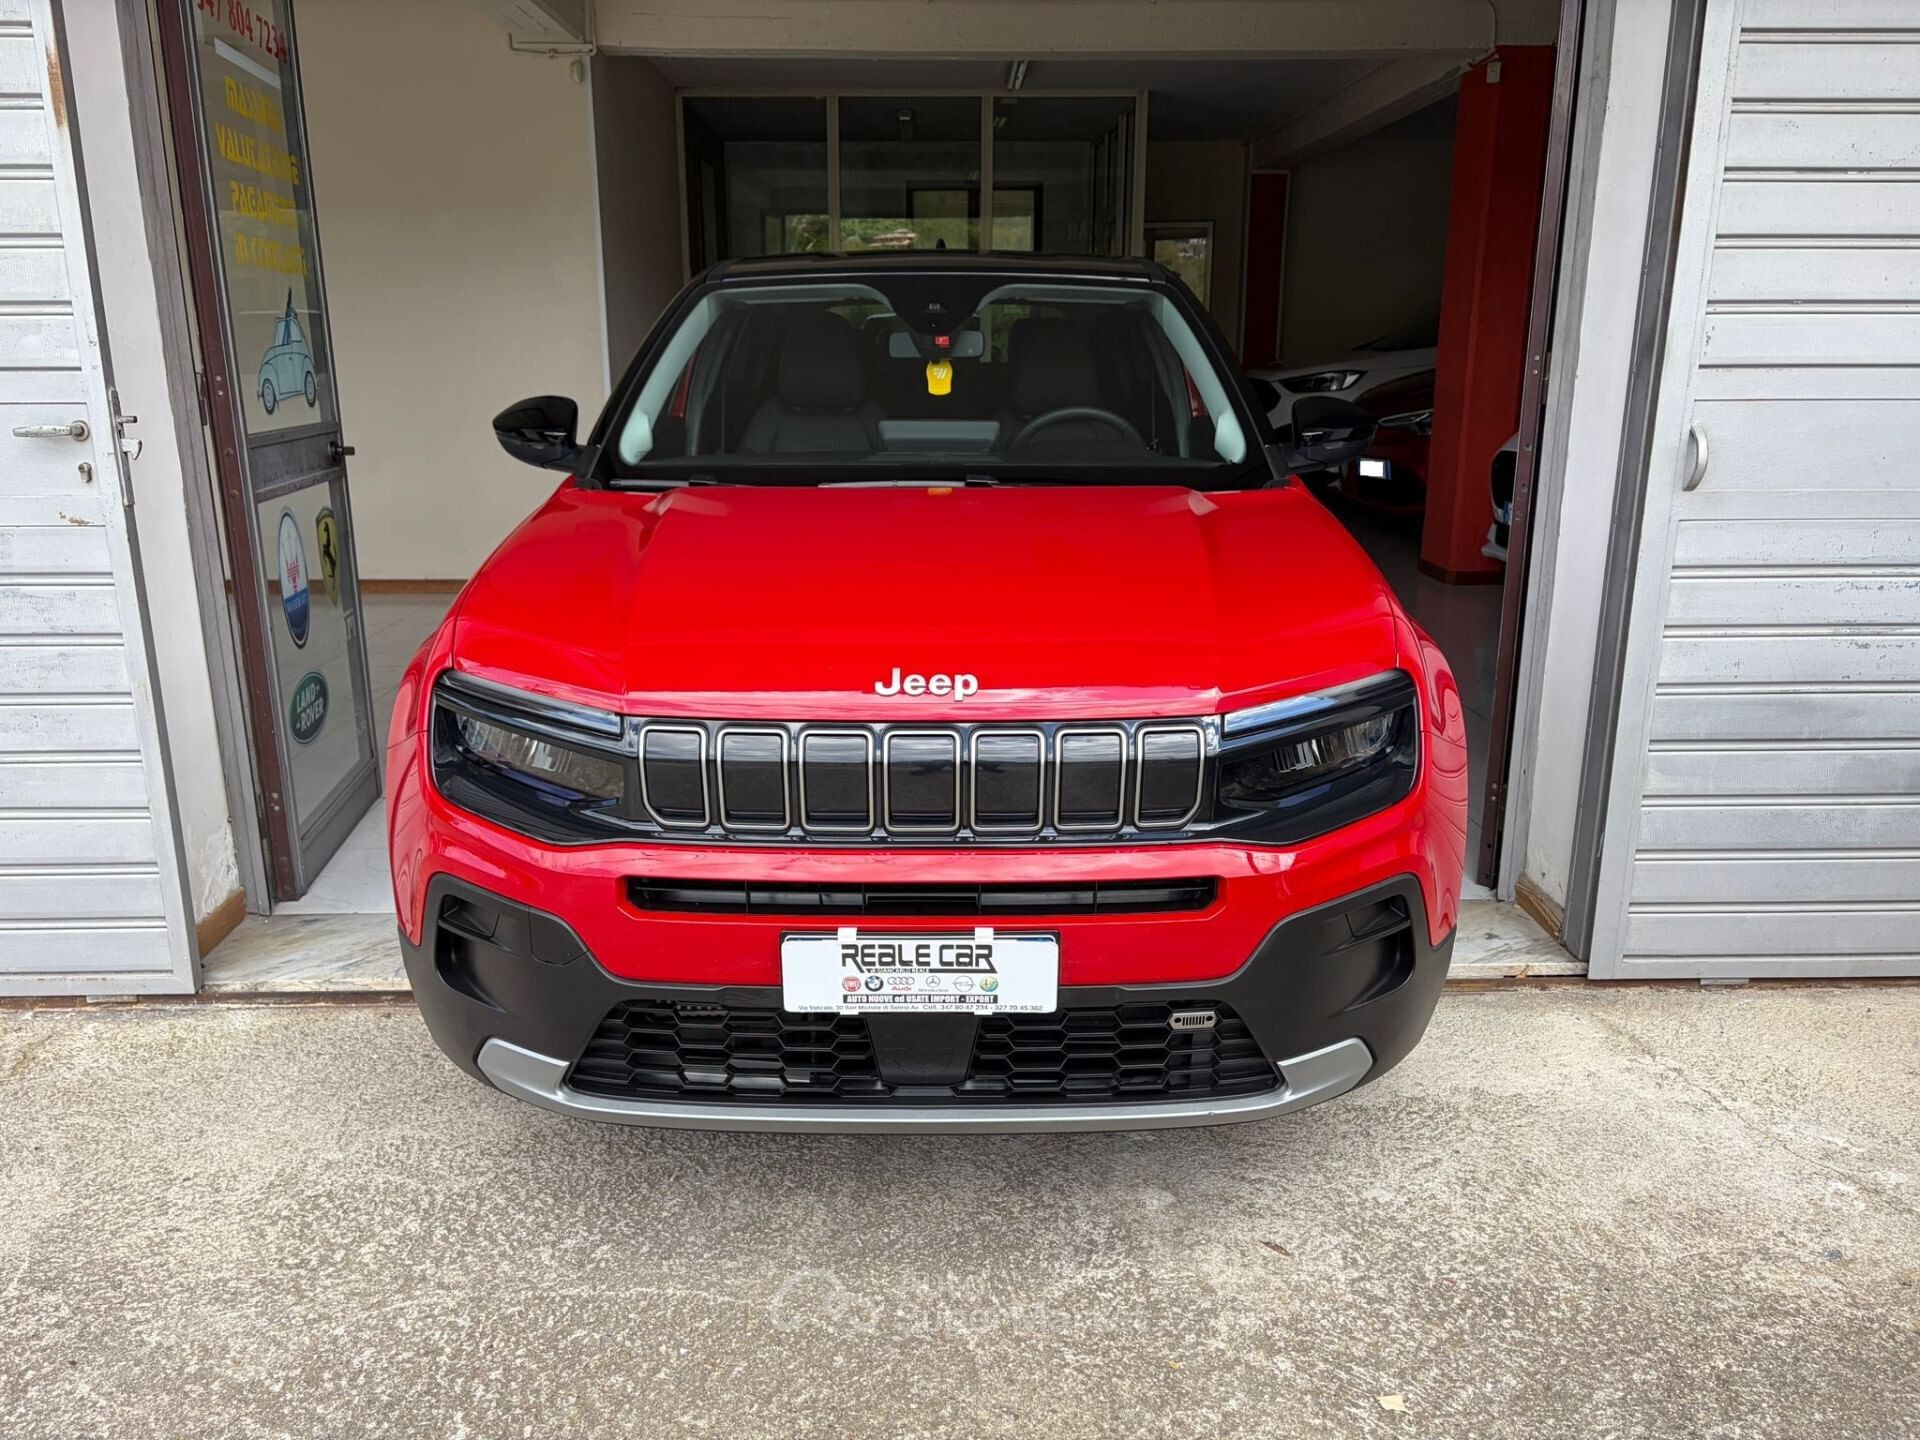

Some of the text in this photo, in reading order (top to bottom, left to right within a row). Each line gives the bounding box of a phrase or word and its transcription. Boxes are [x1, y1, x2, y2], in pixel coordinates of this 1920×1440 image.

[227, 0, 254, 43] 804
[256, 14, 288, 64] 7234
[296, 683, 316, 714] LAND
[874, 667, 979, 702] Jeep
[300, 697, 324, 732] ROVER
[847, 995, 867, 1003] AUTO
[868, 995, 894, 1003] NUOVE
[906, 995, 929, 1003] USATE
[930, 995, 960, 1003] IMPORT
[966, 995, 994, 1003] EXPORT
